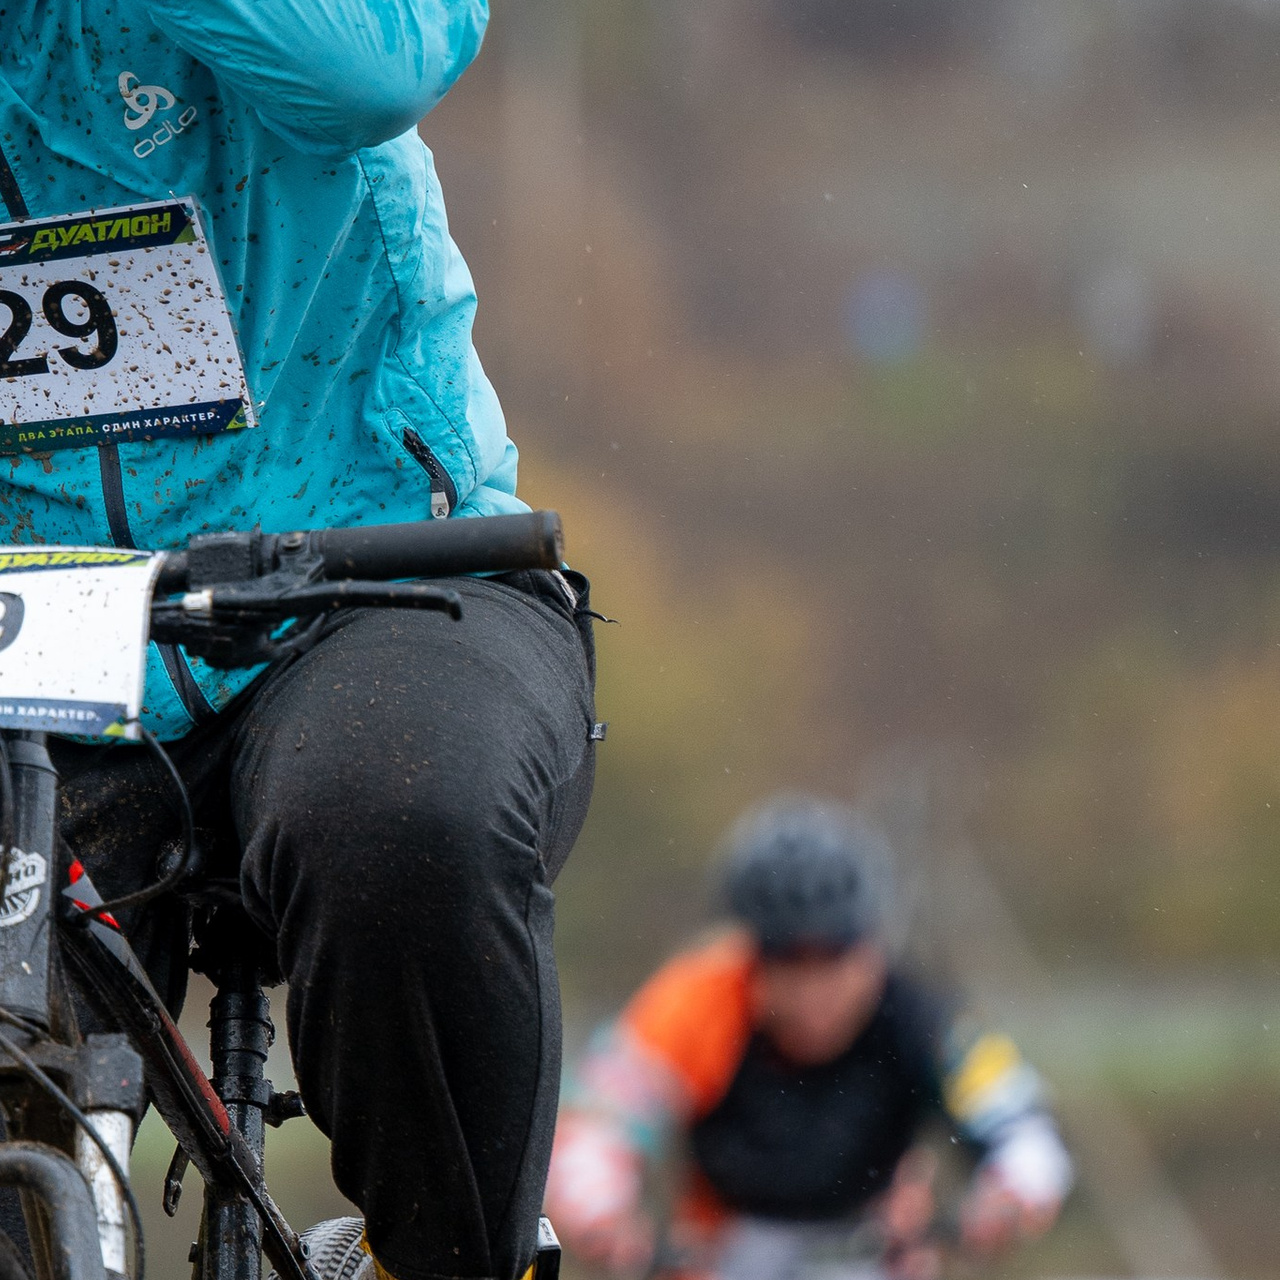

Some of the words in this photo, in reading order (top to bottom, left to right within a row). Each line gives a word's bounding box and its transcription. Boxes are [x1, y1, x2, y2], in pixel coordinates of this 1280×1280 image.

[28, 212, 172, 255] ДУАТЛОН
[18, 432, 46, 443] ДВА
[102, 421, 141, 433] ОДИН
